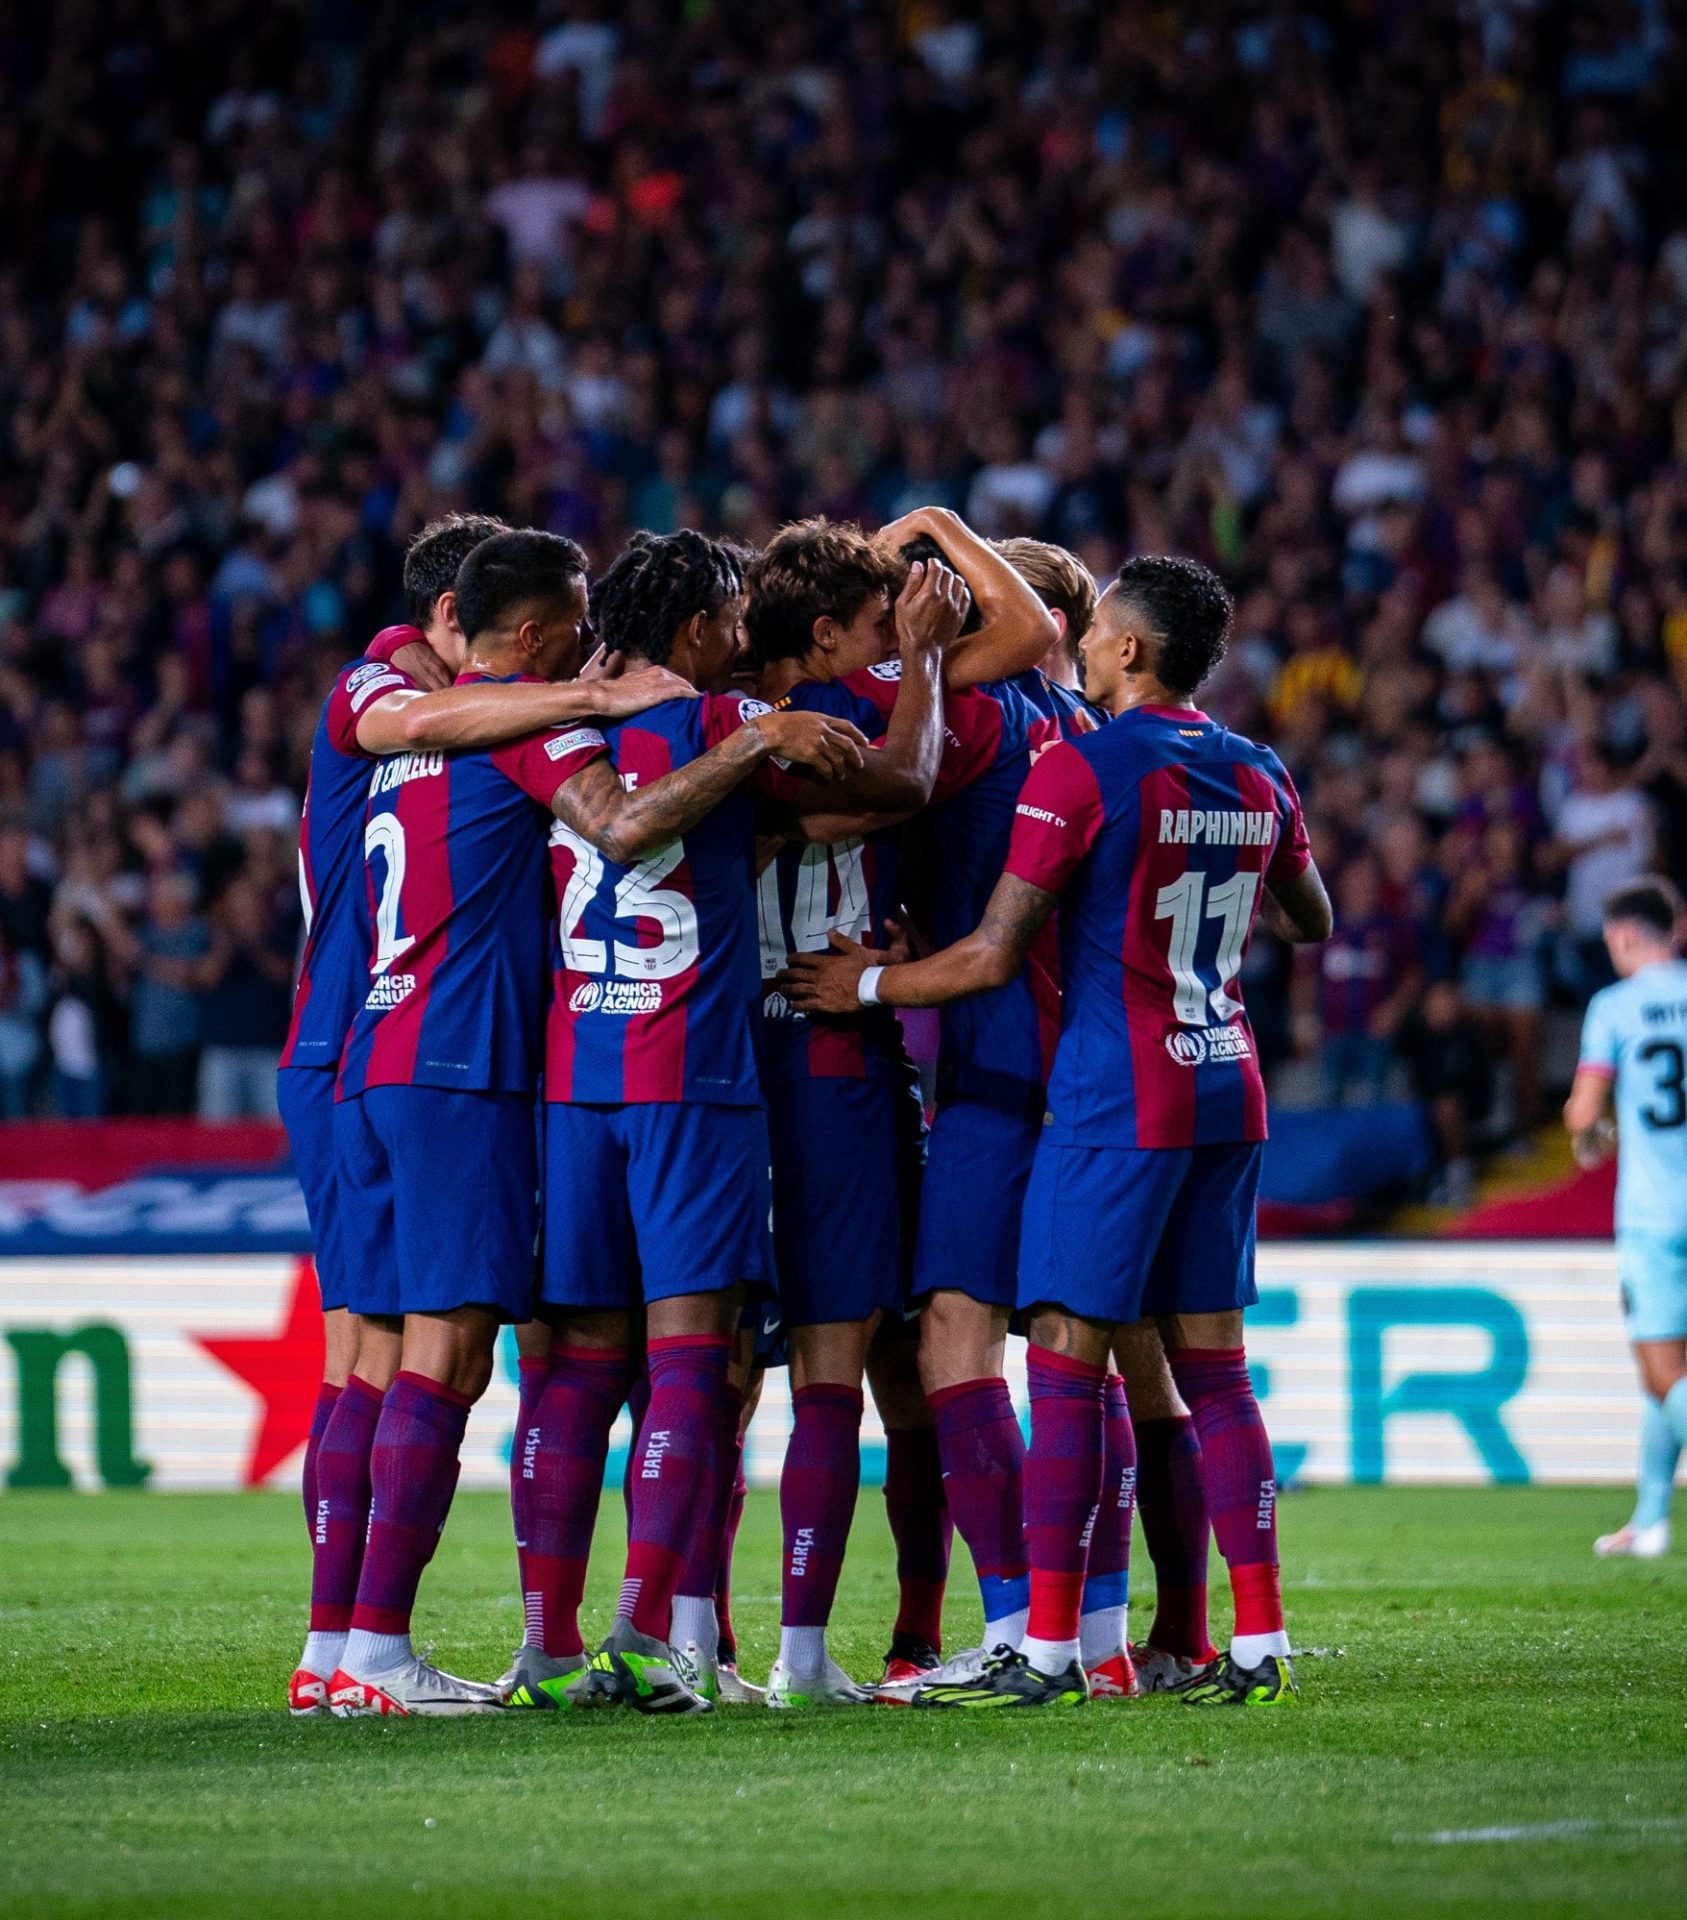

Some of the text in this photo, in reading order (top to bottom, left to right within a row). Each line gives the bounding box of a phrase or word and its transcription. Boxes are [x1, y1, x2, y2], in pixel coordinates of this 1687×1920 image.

[381, 750, 443, 793] CANCELO
[1055, 817, 1067, 828] tv
[1158, 809, 1274, 845] RAPHINHA
[365, 812, 416, 974] 2
[548, 818, 700, 979] 23
[757, 837, 871, 978] 14
[1155, 871, 1260, 1026] 11
[373, 974, 416, 989] HCR
[601, 995, 662, 1010] ACNUR
[605, 981, 662, 997] UNHCR
[523, 1428, 541, 1479] BARÇA
[642, 1430, 670, 1478] BARÇA
[316, 1500, 330, 1544] BARÇA
[791, 1528, 814, 1576] BARÇA
